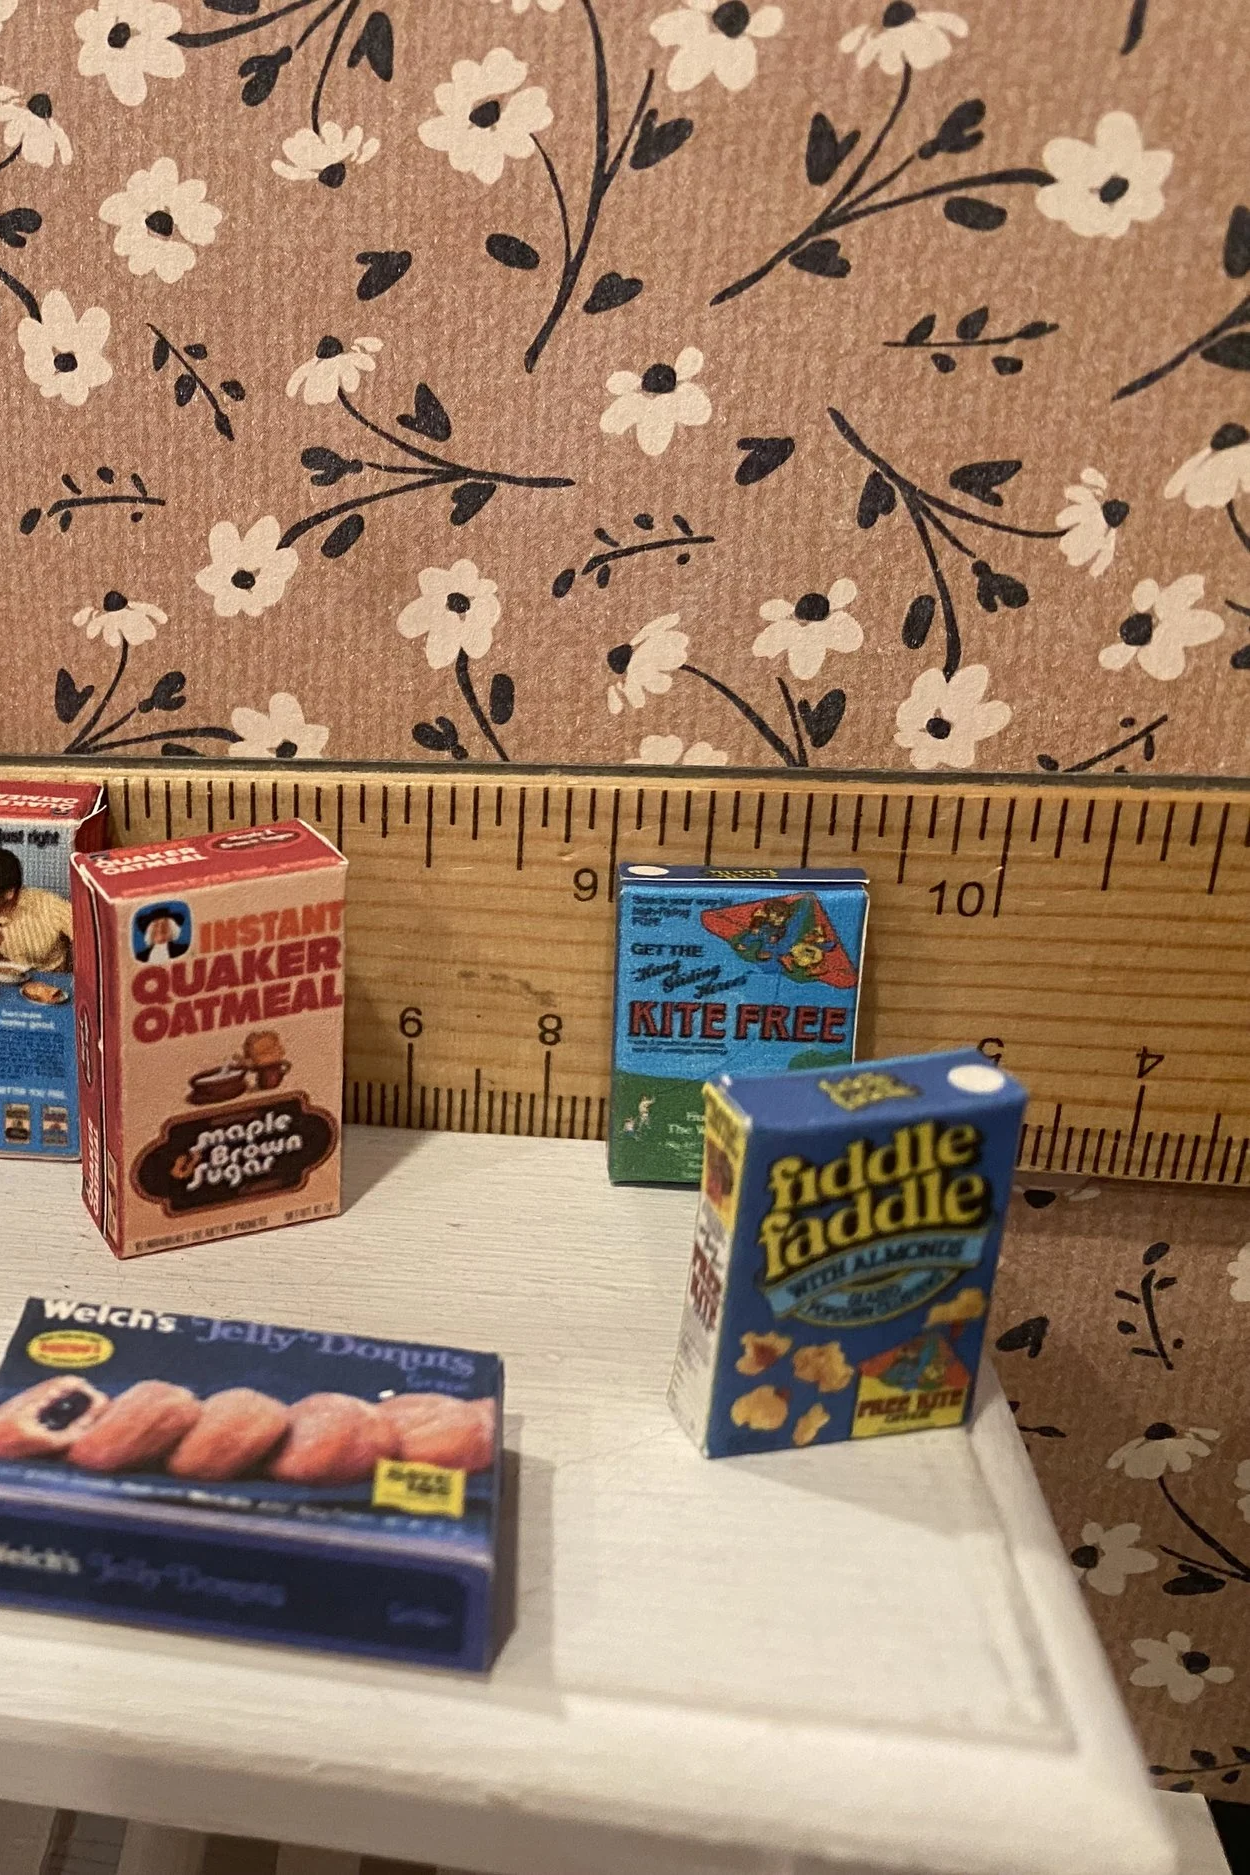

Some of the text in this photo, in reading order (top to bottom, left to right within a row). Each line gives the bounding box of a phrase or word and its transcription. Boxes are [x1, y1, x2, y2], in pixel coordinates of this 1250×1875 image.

[28, 830, 60, 848] right
[95, 846, 198, 868] QUAKER
[101, 854, 209, 876] OATMEAL
[573, 867, 598, 902] 9
[929, 880, 986, 918] 10
[200, 900, 345, 953] INSTANT
[631, 943, 703, 958] GET THE
[131, 936, 342, 1006] QUAKER
[131, 974, 343, 1044] OATMEAL
[627, 1001, 848, 1043] KITE FREE
[538, 1014, 563, 1046] 8
[1136, 1046, 1165, 1079] 4
[210, 1133, 303, 1168] Brown
[766, 1120, 984, 1212] fiddle
[757, 1170, 987, 1280] faddle
[42, 1298, 178, 1334] Welch's
